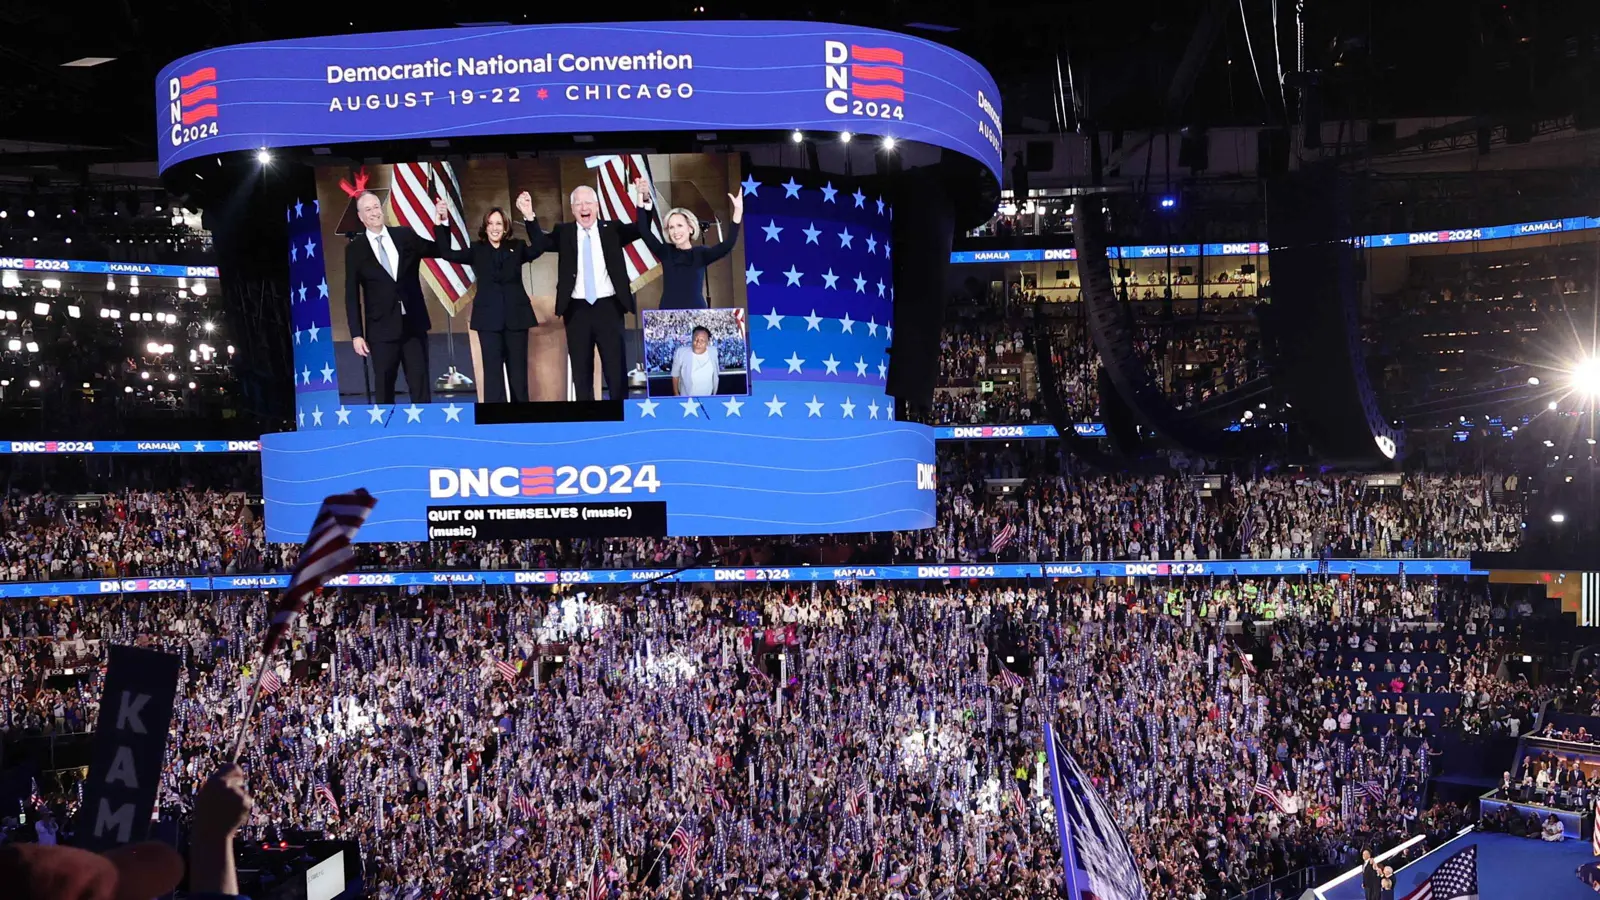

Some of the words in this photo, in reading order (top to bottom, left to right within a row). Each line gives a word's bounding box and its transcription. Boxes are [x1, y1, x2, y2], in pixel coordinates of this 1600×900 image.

[327, 57, 452, 84] Democratic
[457, 54, 552, 76] National
[558, 49, 693, 73] Convention
[825, 40, 849, 115] DNC
[329, 91, 434, 112] AUGUST
[448, 86, 521, 106] 19-22
[565, 82, 694, 101] CHICAGO
[169, 77, 182, 147] DNC
[852, 99, 905, 121] 2024
[183, 121, 219, 143] 2024
[1521, 220, 1563, 233] KAMALA
[1409, 231, 1439, 244] DNC
[1448, 229, 1482, 241] 2024
[1044, 249, 1071, 261] DNC
[1222, 243, 1250, 254] DNC
[975, 252, 1011, 260] KAMALA
[34, 259, 70, 271] 2024
[110, 264, 151, 273] KAMALA
[187, 266, 216, 277] DNC
[954, 425, 983, 438] DNC
[991, 425, 1024, 437] 2024
[11, 441, 46, 452] DNC
[57, 441, 94, 452] 2024
[137, 442, 181, 450] KAMALA
[228, 440, 257, 451] DNC
[429, 466, 520, 499] DNC
[555, 464, 661, 495] 2024
[428, 510, 461, 522] QUIT
[464, 509, 485, 521] ON
[487, 507, 579, 520] THEMSELVES
[581, 506, 633, 520] (music)
[428, 525, 477, 539] (music)
[714, 569, 746, 581] DNC
[918, 565, 949, 578] DNC
[960, 565, 995, 577] 2024
[1125, 563, 1157, 576] DNC
[358, 573, 392, 585] 2024
[514, 571, 546, 583] DNC
[100, 580, 136, 593] DNC
[148, 578, 187, 590] 2024
[93, 689, 152, 844] KAM
